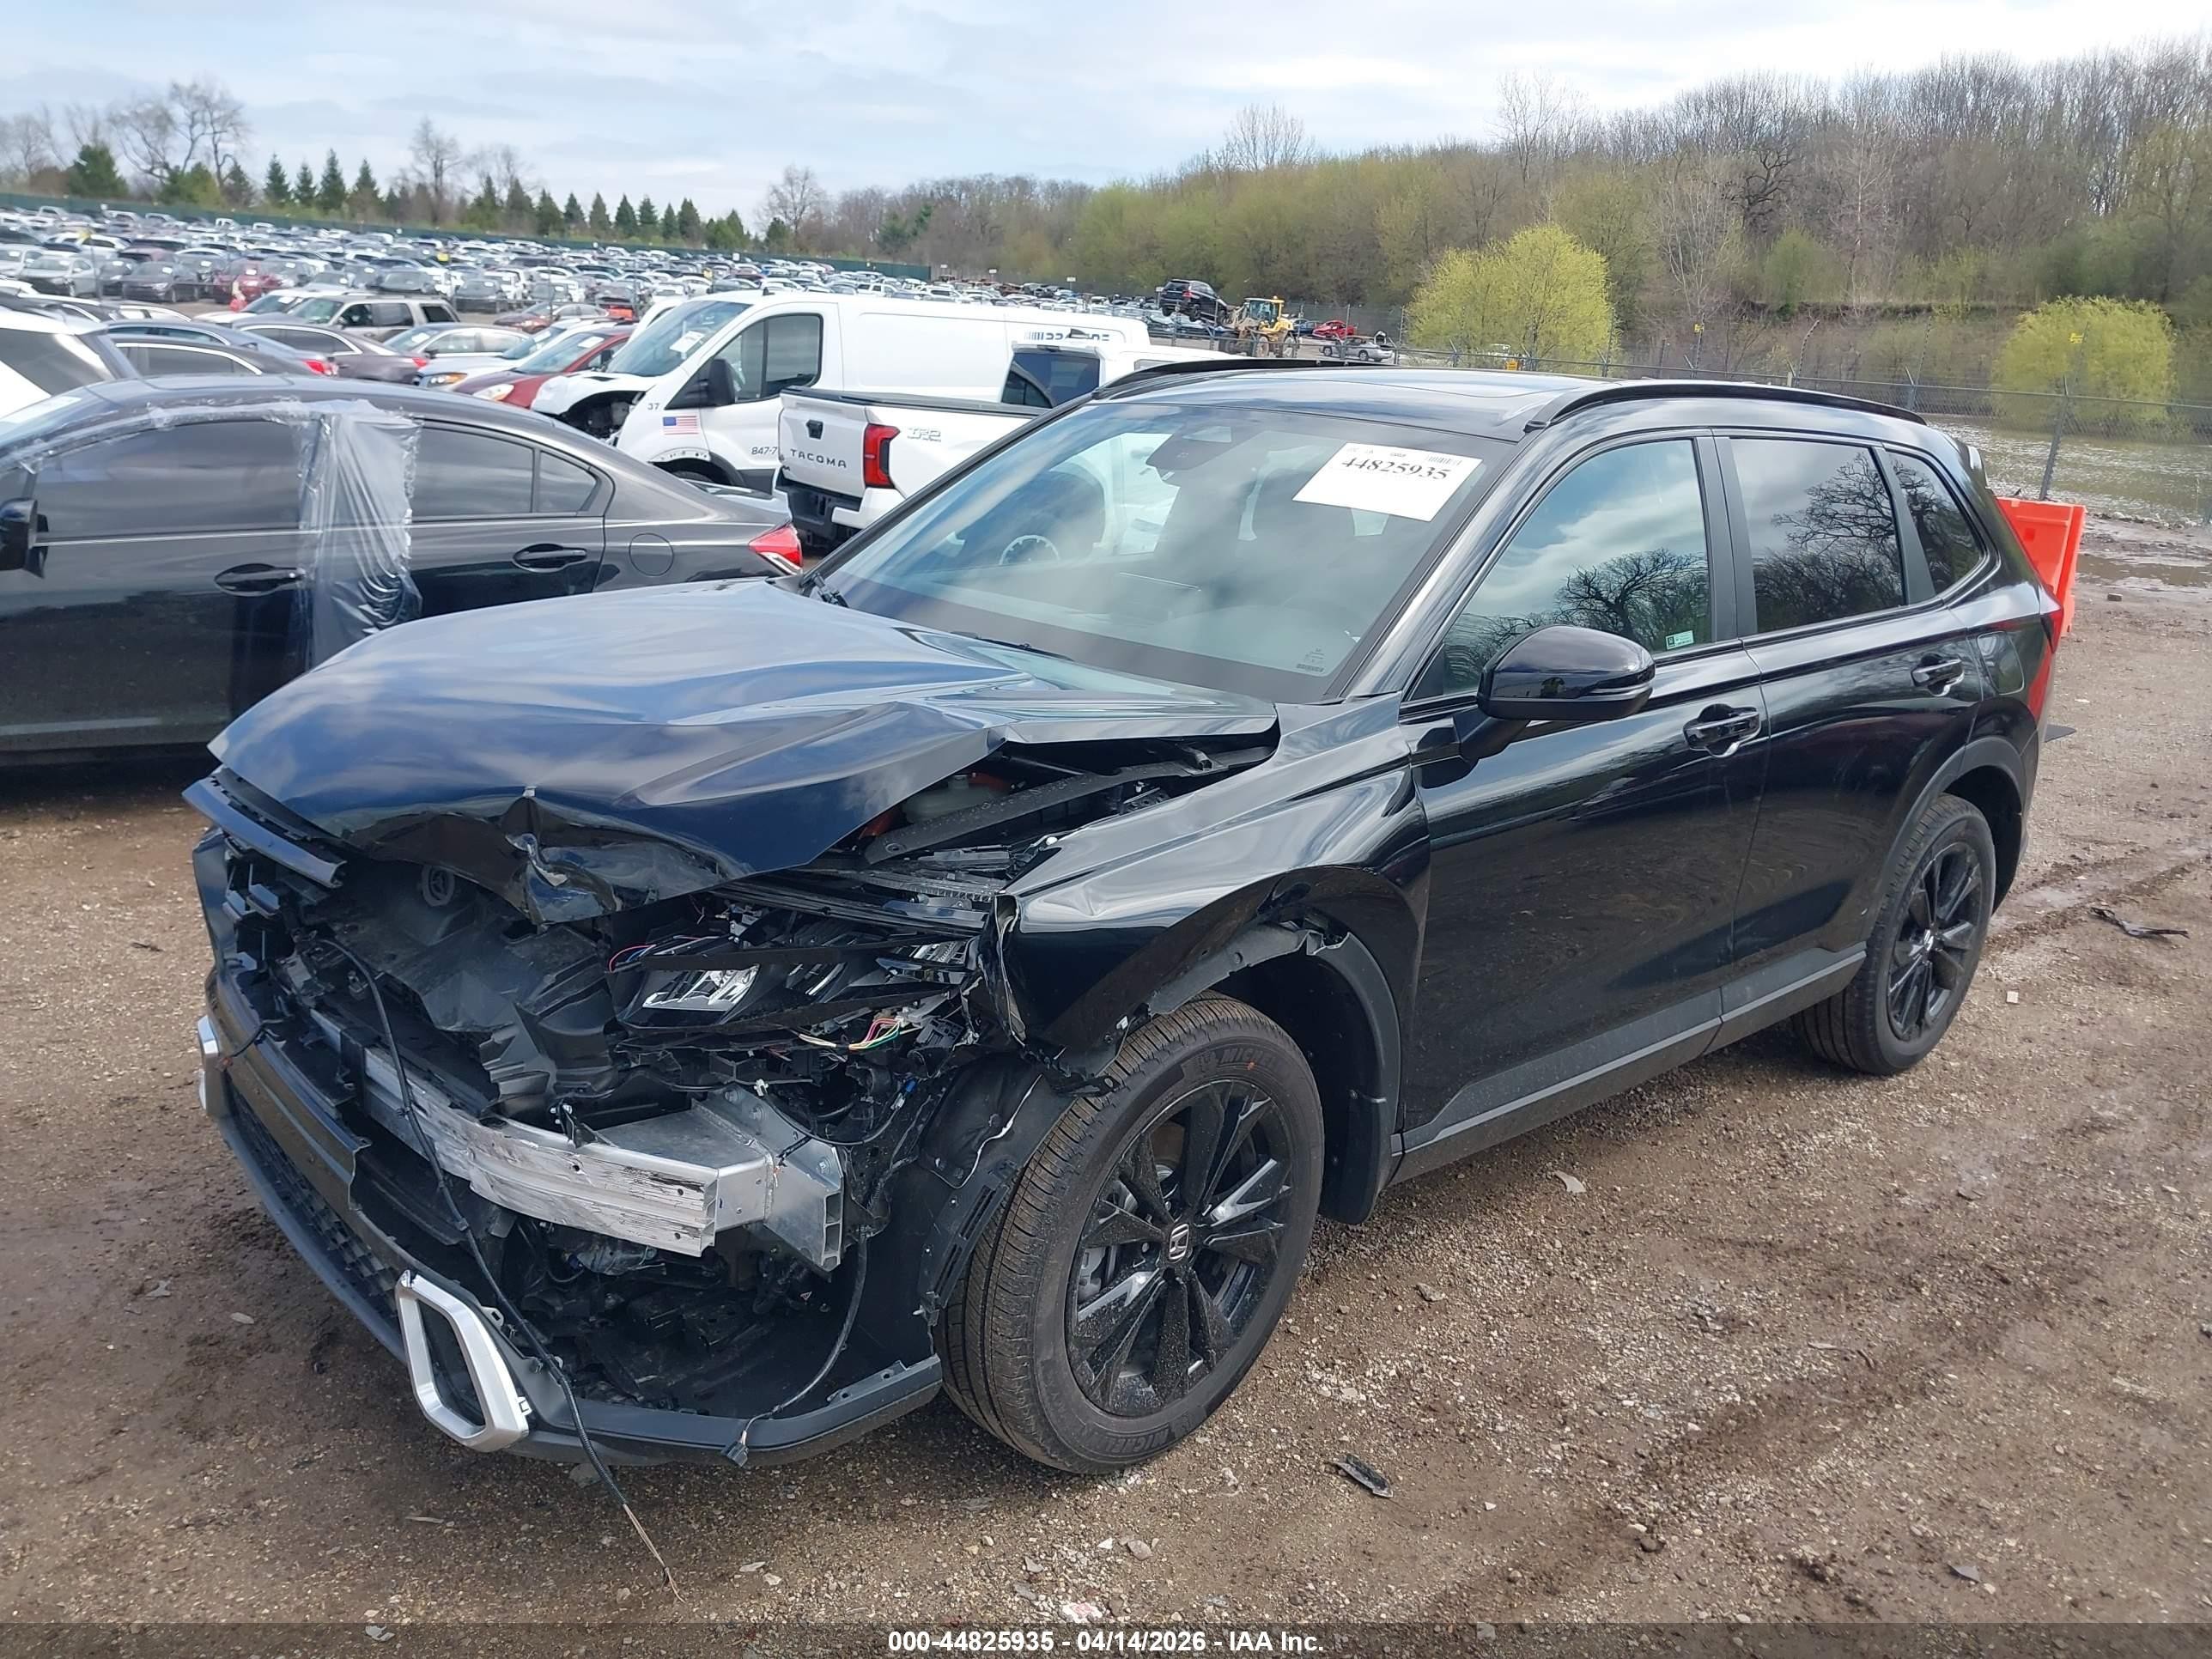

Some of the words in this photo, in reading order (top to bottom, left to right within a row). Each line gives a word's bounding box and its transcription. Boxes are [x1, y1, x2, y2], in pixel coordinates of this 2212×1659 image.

[790, 448, 847, 468] TACOMA
[1342, 457, 1452, 480] 44825935
[1220, 1048, 1285, 1073] MICHEL
